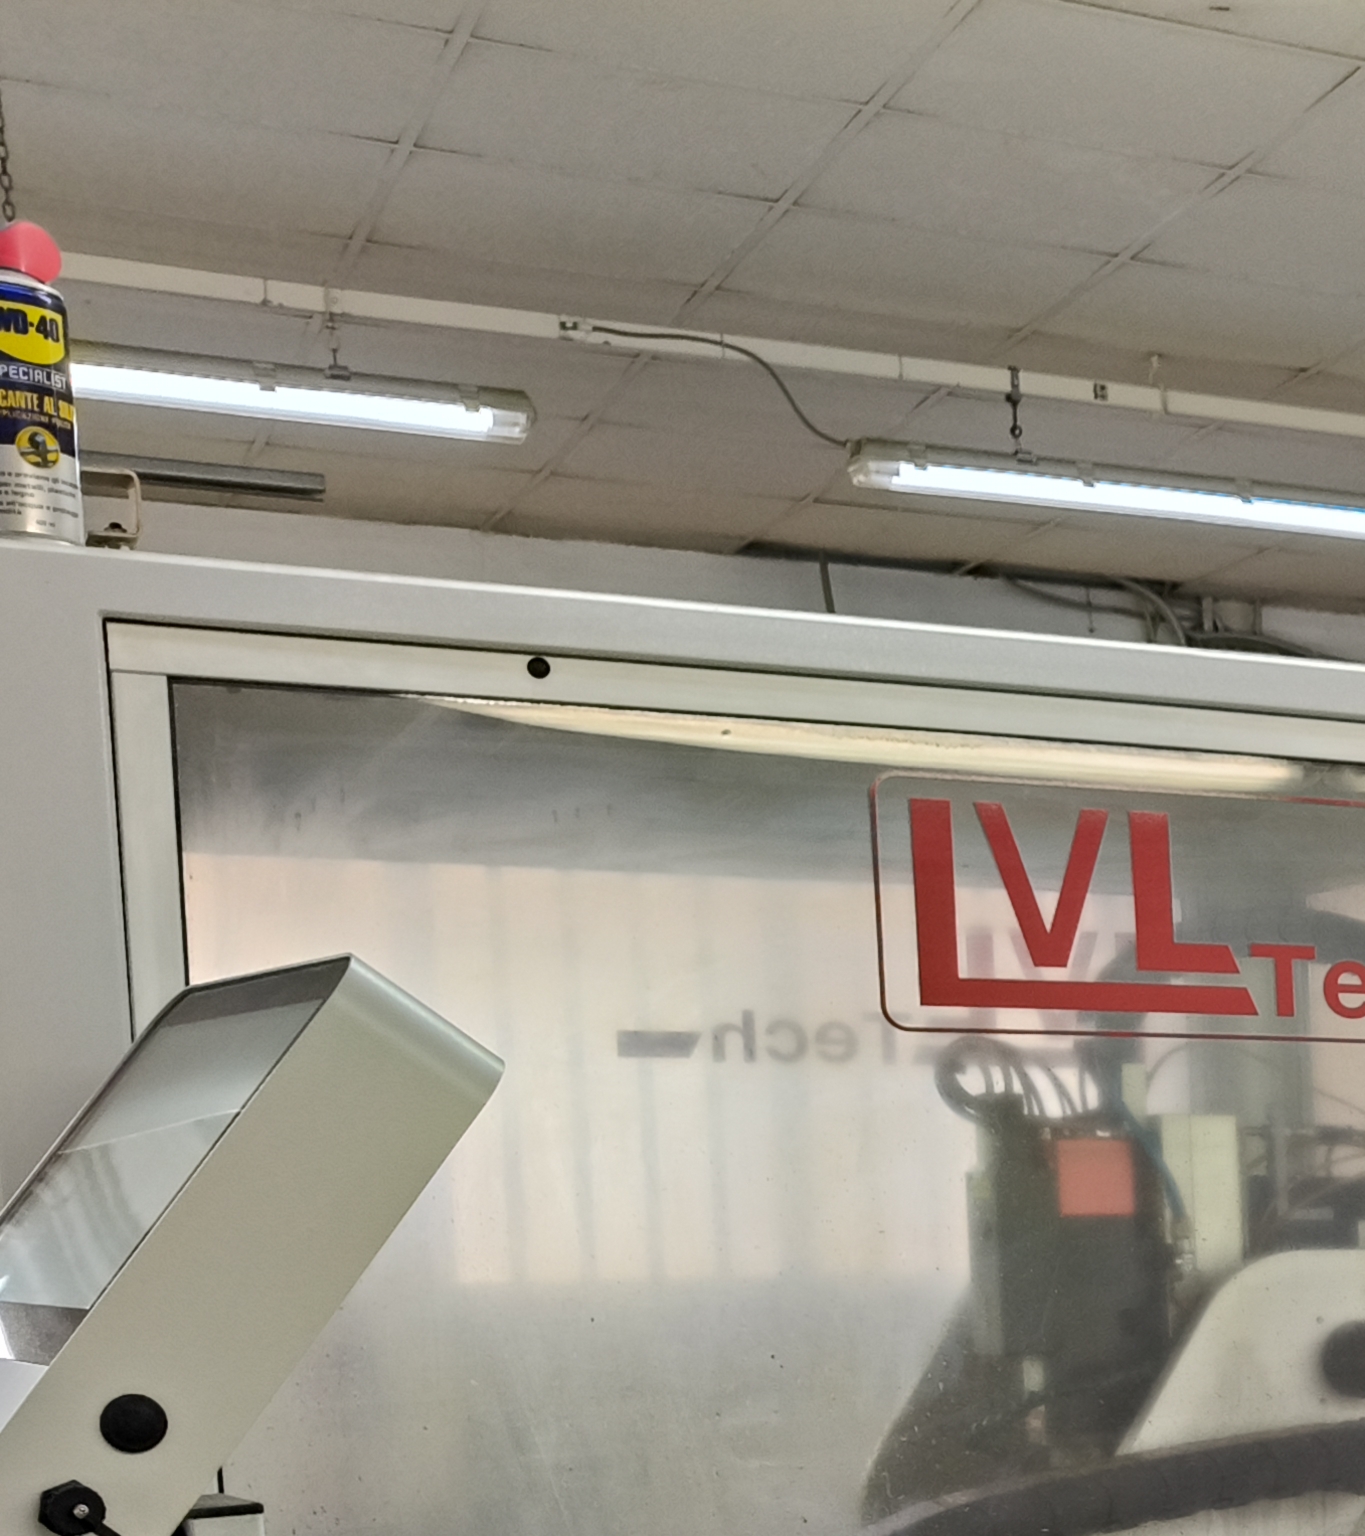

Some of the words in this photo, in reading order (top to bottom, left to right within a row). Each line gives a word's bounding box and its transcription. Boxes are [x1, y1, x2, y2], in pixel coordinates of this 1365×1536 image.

[0, 364, 66, 390] PECIALIST
[0, 388, 40, 412] CANTE
[909, 797, 1259, 1016] LVL
